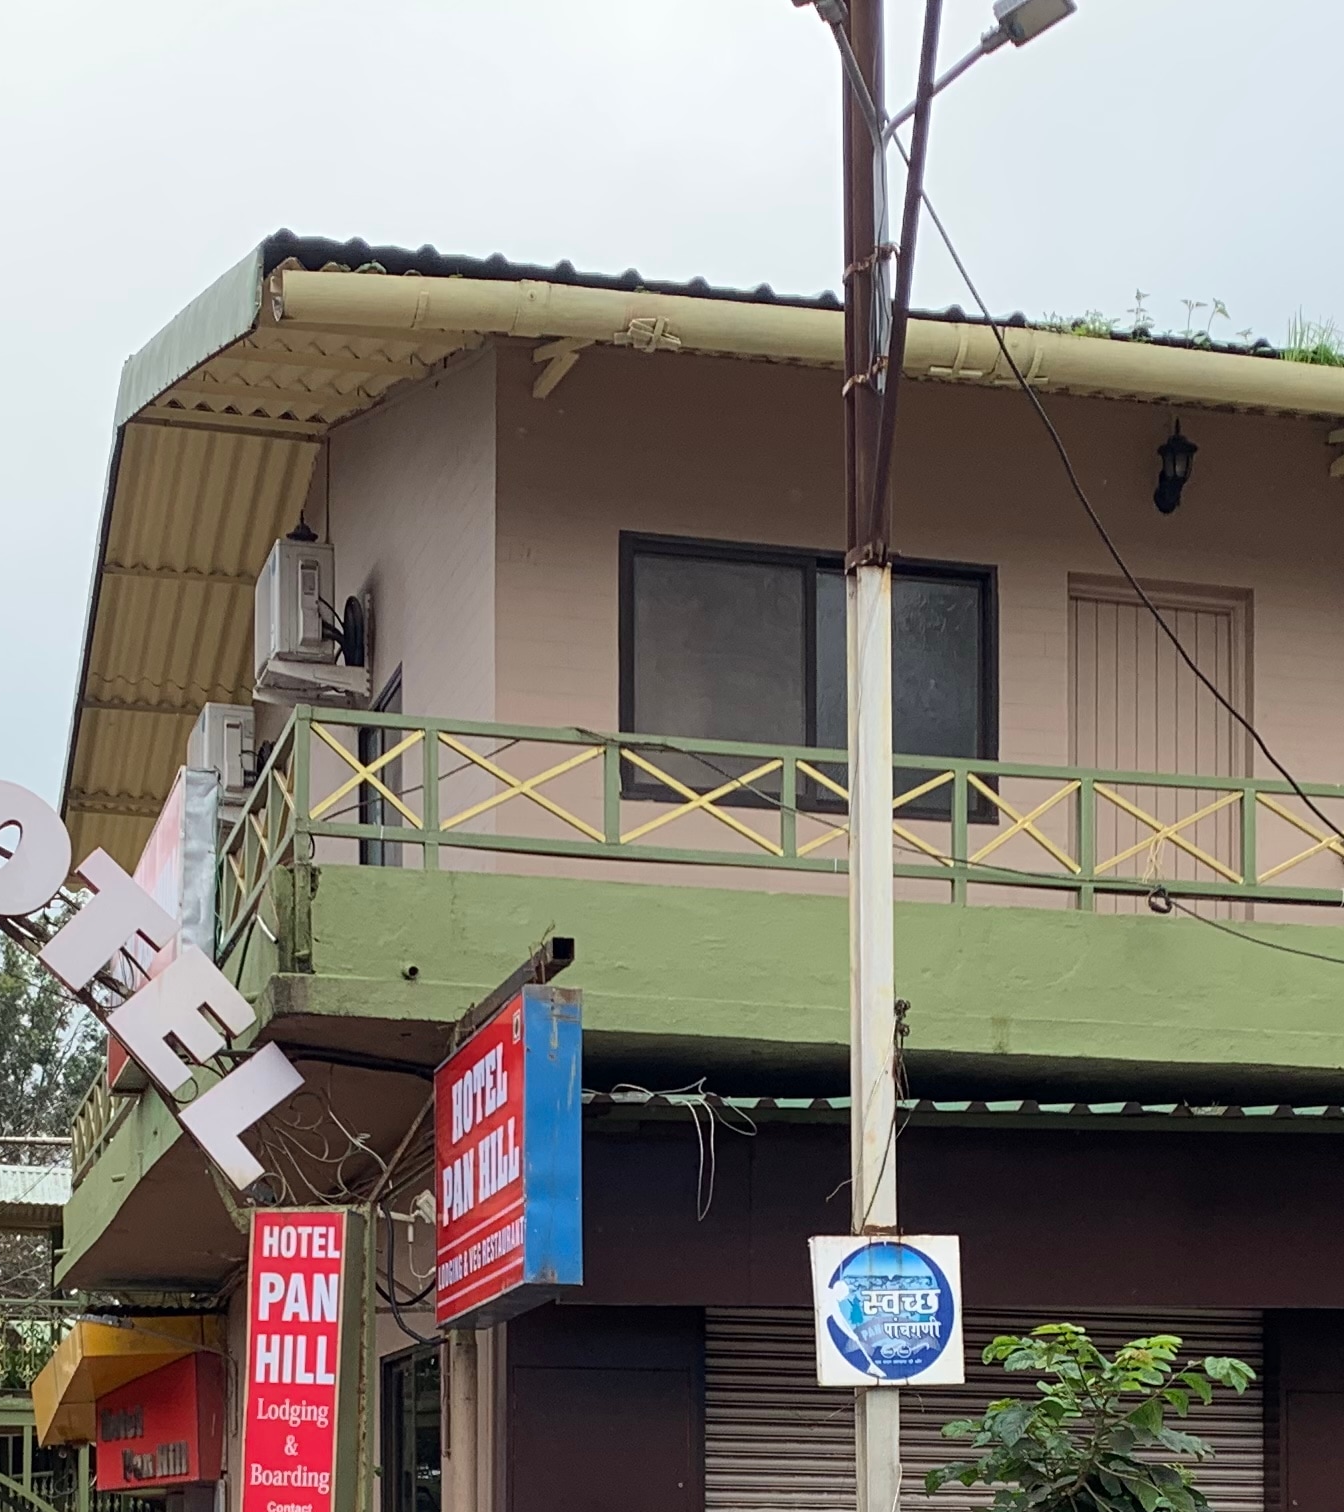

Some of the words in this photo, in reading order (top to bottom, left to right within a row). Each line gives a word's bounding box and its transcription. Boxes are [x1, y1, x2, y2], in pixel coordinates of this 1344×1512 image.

[451, 1042, 508, 1144] HOTEL
[442, 1147, 475, 1228] PAN
[478, 1117, 520, 1203] HILL
[262, 1225, 340, 1258] HOTEL
[438, 1253, 462, 1291] LODGING
[463, 1252, 468, 1277] &
[469, 1243, 481, 1274] VEG
[482, 1216, 526, 1266] RESTAURANT
[258, 1272, 339, 1322] PAN
[861, 1289, 941, 1316] स्वच्छ
[884, 1316, 941, 1339] पांचगणी
[255, 1334, 335, 1385] HILL
[257, 1397, 329, 1428] Lodging
[284, 1434, 299, 1456] &
[250, 1463, 330, 1495] Boarding
